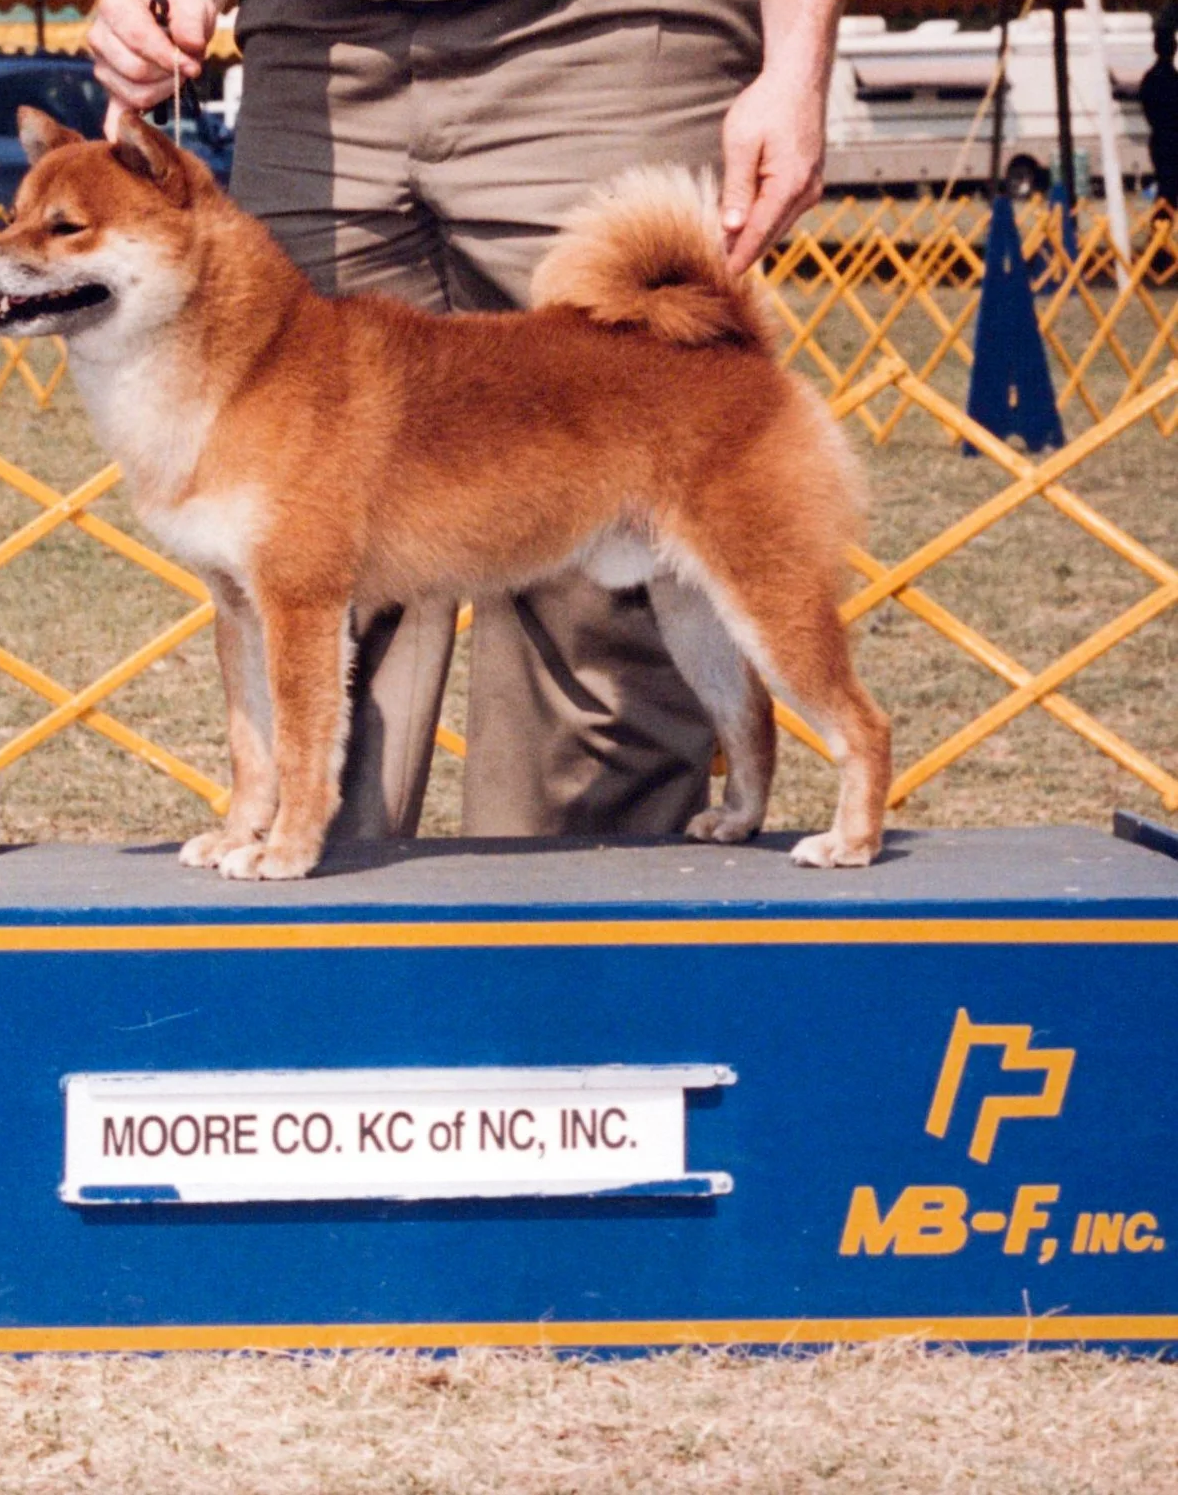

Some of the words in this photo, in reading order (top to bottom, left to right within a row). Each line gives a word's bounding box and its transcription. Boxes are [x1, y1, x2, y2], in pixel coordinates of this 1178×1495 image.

[103, 1114, 258, 1157] MOORE
[272, 1113, 342, 1155] CO.
[360, 1111, 414, 1153] KC
[429, 1110, 465, 1152] of
[479, 1109, 545, 1158] NC,
[562, 1108, 637, 1149] INC.
[839, 1184, 1060, 1264] MB-F,
[1071, 1211, 1165, 1254] INC.
